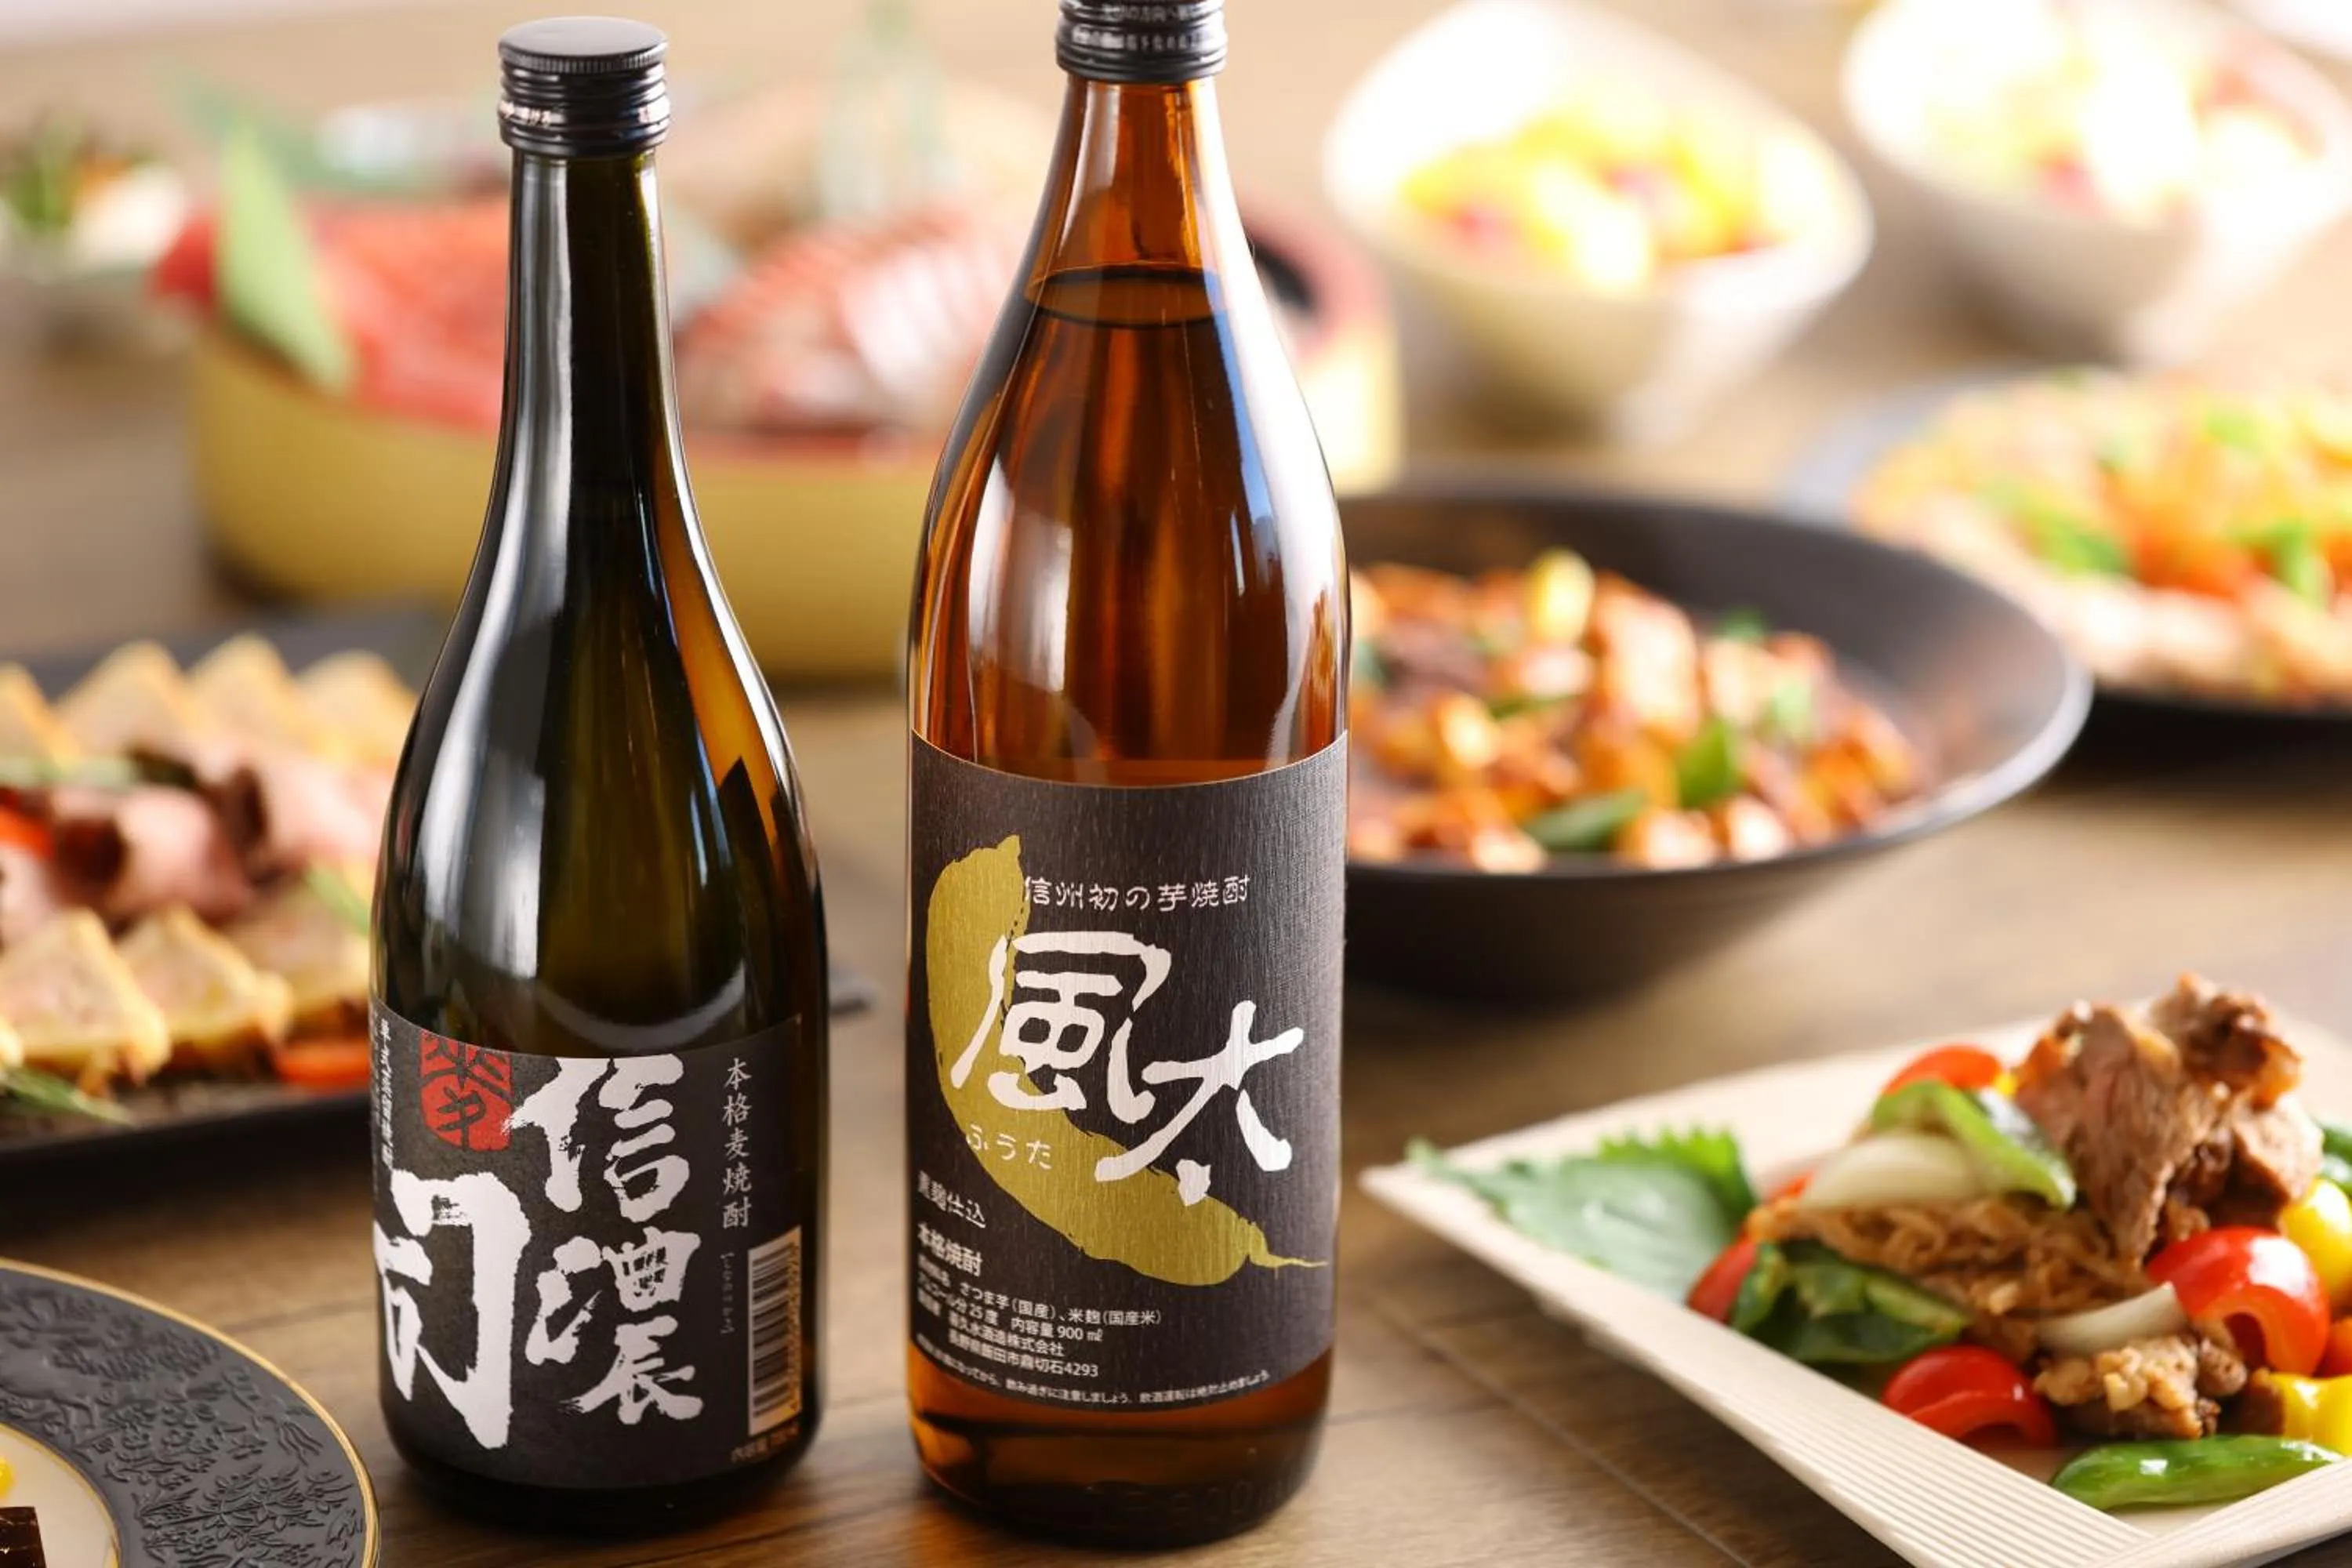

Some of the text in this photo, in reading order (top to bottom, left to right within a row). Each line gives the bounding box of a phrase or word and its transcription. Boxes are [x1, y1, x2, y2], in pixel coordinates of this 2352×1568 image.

[1024, 873, 1251, 912] 信州初の芋焼酎
[949, 931, 1305, 1207] 風太
[721, 1057, 753, 1229] 本格麦焼酎
[965, 1123, 1053, 1171] ふうた
